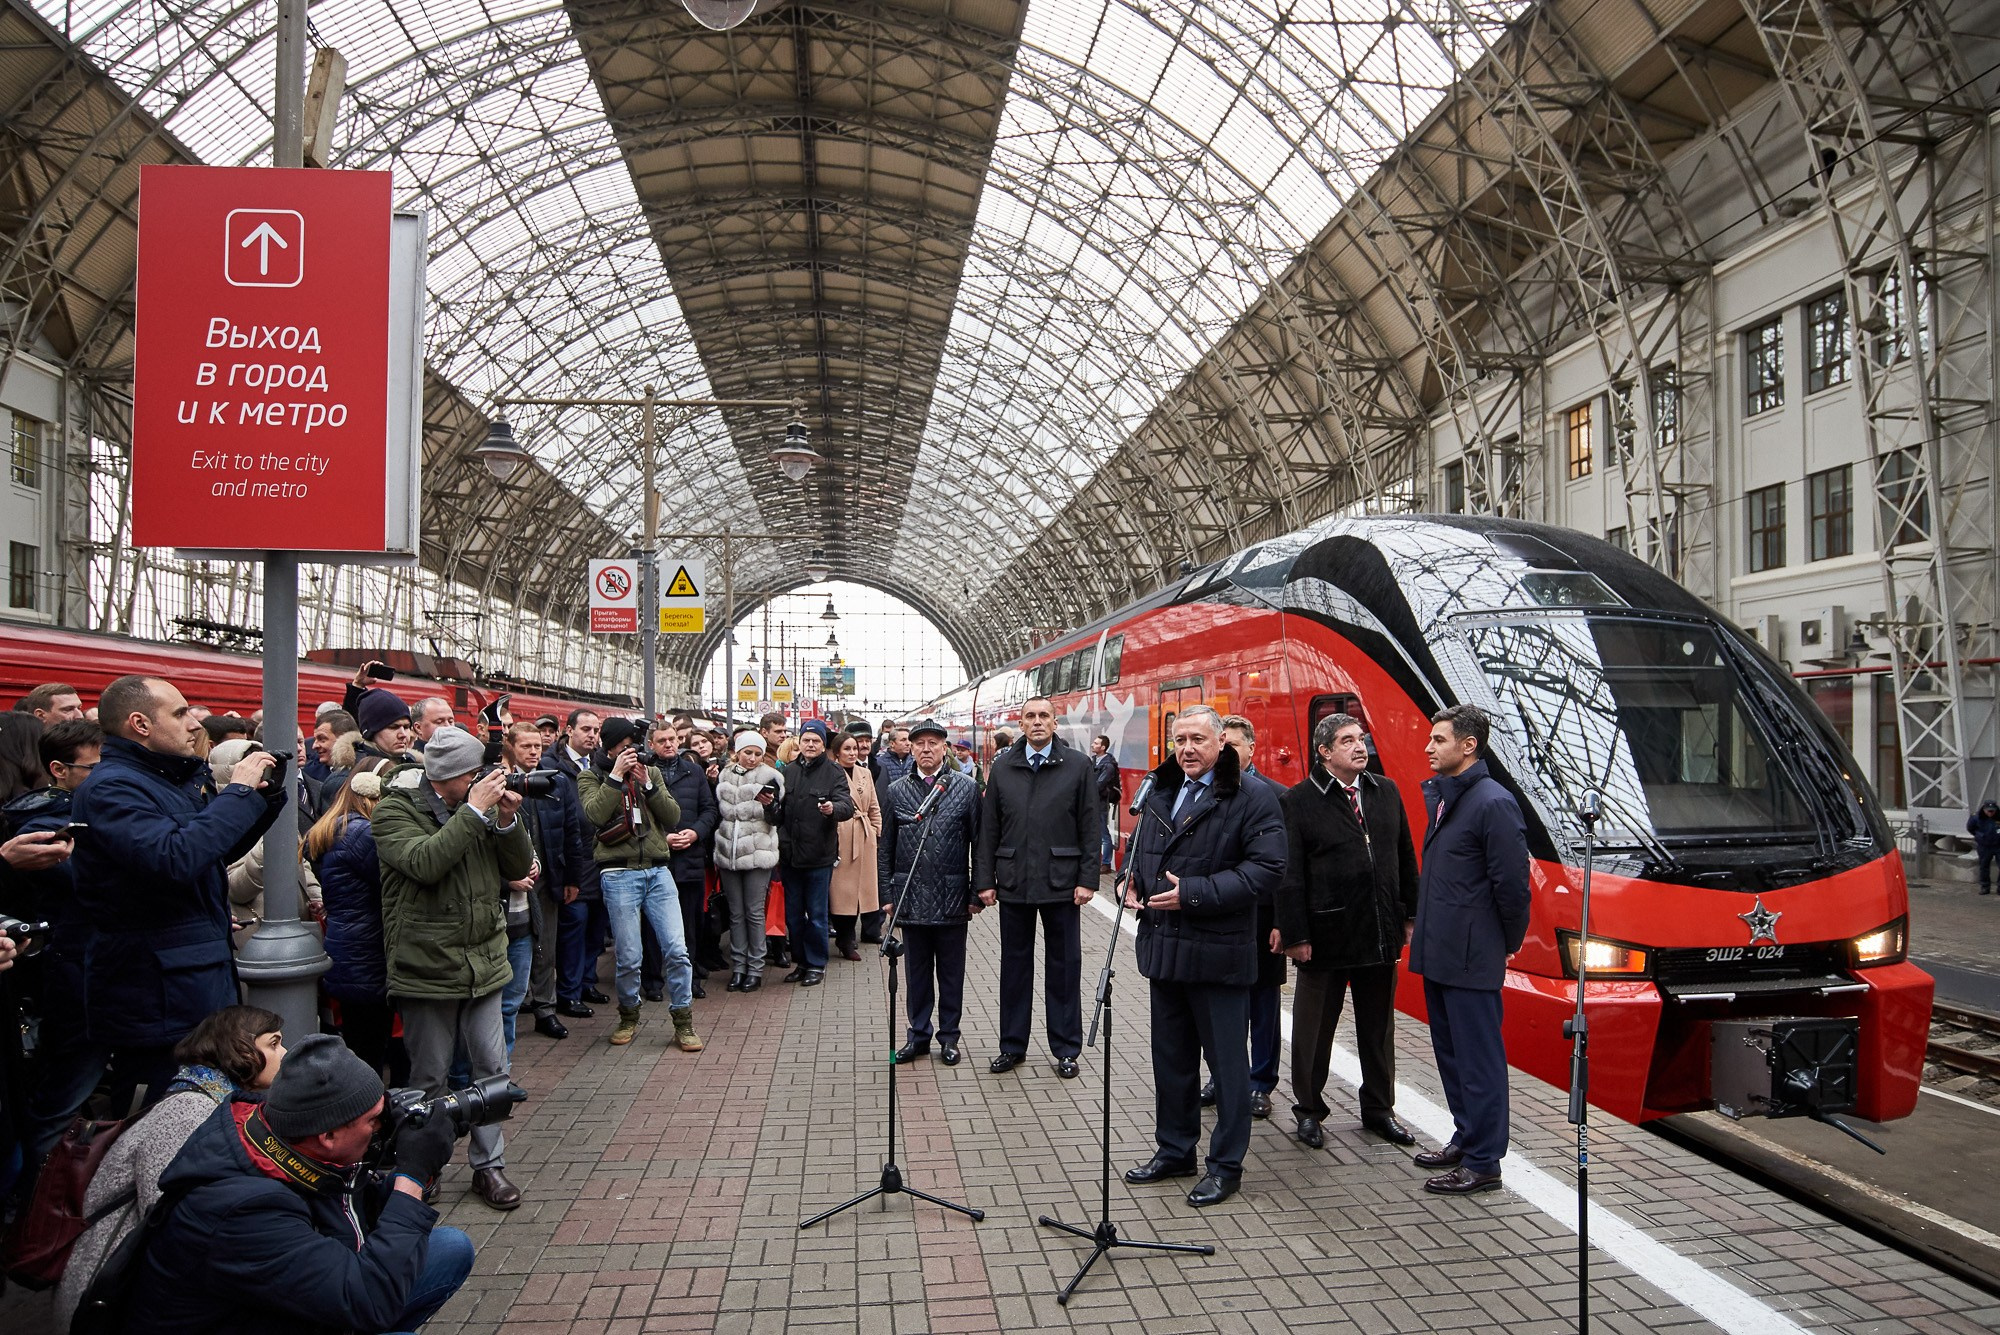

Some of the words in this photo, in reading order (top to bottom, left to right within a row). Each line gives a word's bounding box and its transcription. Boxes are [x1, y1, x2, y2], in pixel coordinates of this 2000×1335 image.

[205, 317, 322, 354] Выход
[196, 362, 218, 386] в
[228, 363, 329, 395] город
[177, 400, 199, 424] и
[208, 401, 230, 425] к
[238, 402, 348, 434] метро
[191, 450, 229, 470] Exit
[234, 453, 254, 470] to
[260, 451, 290, 471] the
[294, 452, 330, 476] city
[211, 478, 248, 497] and
[251, 481, 308, 498] metro
[594, 609, 618, 617] Прыгать
[664, 612, 694, 620] Берегись
[594, 622, 629, 630] запрещено!
[825, 713, 832, 722] 2
[1706, 947, 1744, 962] ЭШ2
[1757, 945, 1785, 959] 024
[287, 1157, 320, 1183] Nikon
